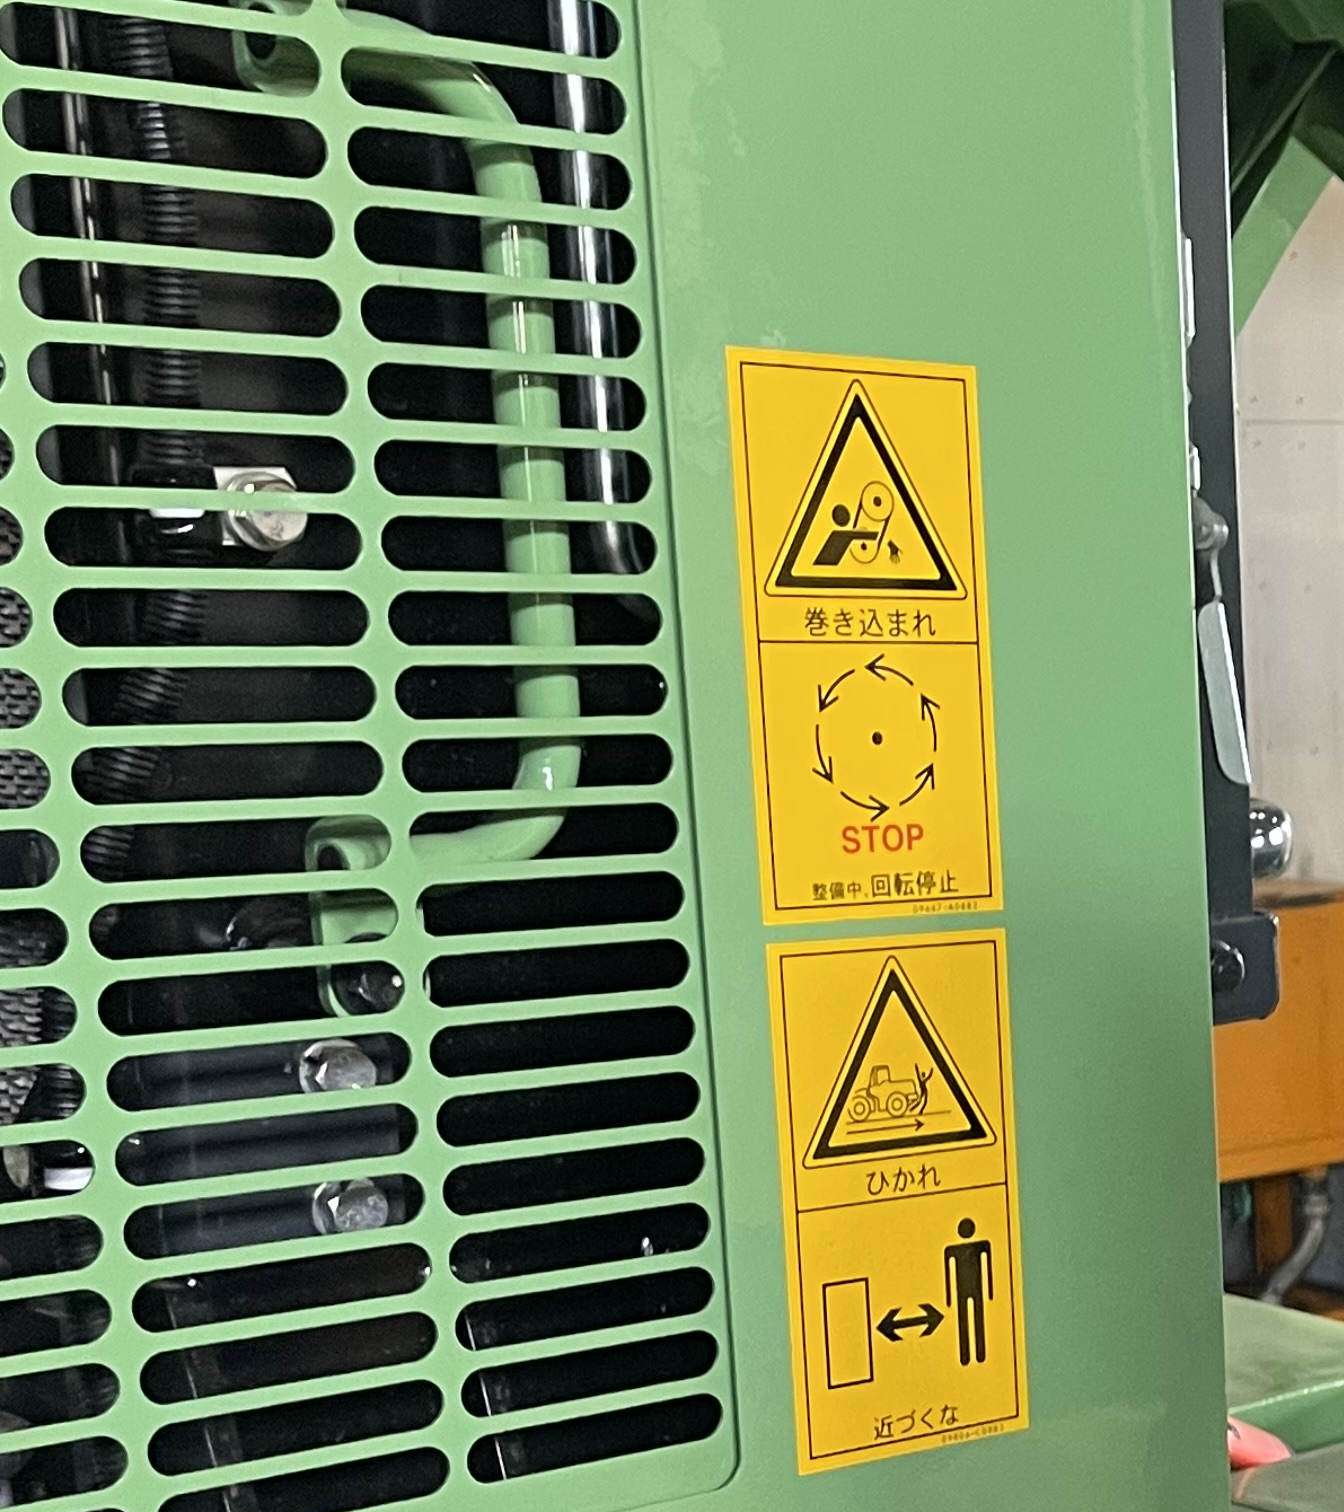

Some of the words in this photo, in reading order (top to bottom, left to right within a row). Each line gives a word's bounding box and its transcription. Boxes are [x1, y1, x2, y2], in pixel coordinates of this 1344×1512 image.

[804, 607, 937, 637] 巻き込まれ
[841, 823, 924, 854] STOP
[812, 869, 959, 901] 整備中、回転停止
[866, 1164, 942, 1195] ひかれ
[874, 1404, 959, 1440] 近づくな
